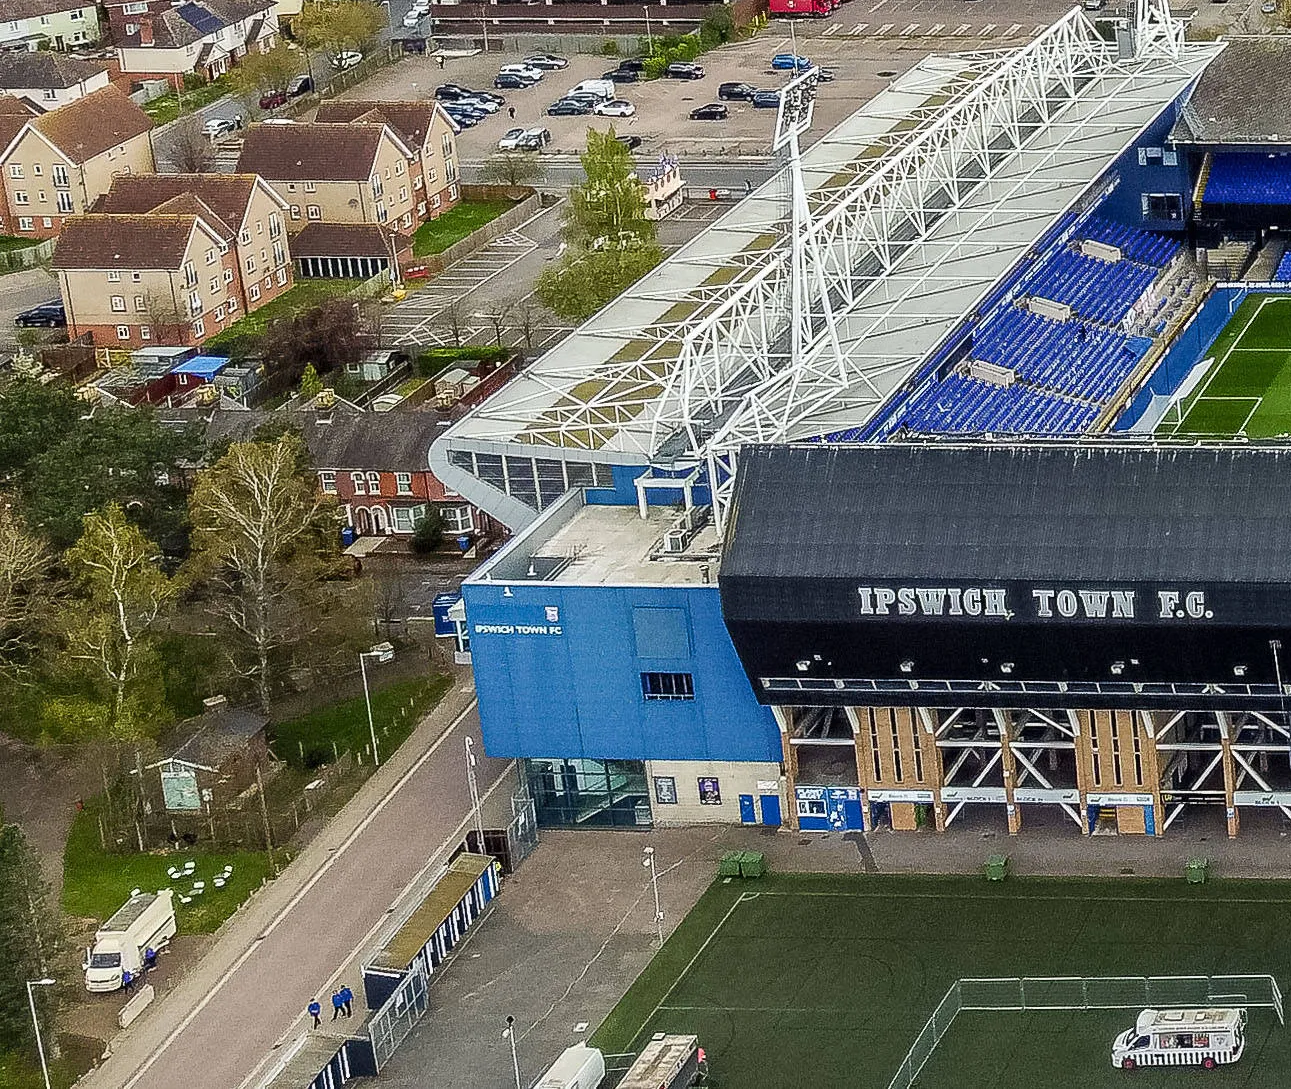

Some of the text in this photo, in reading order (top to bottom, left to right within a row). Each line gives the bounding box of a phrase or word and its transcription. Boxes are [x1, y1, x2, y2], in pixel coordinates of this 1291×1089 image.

[858, 587, 1214, 619] IPSWICH TOWN F.C.
[475, 625, 562, 635] IPSWICH TOWN FC
